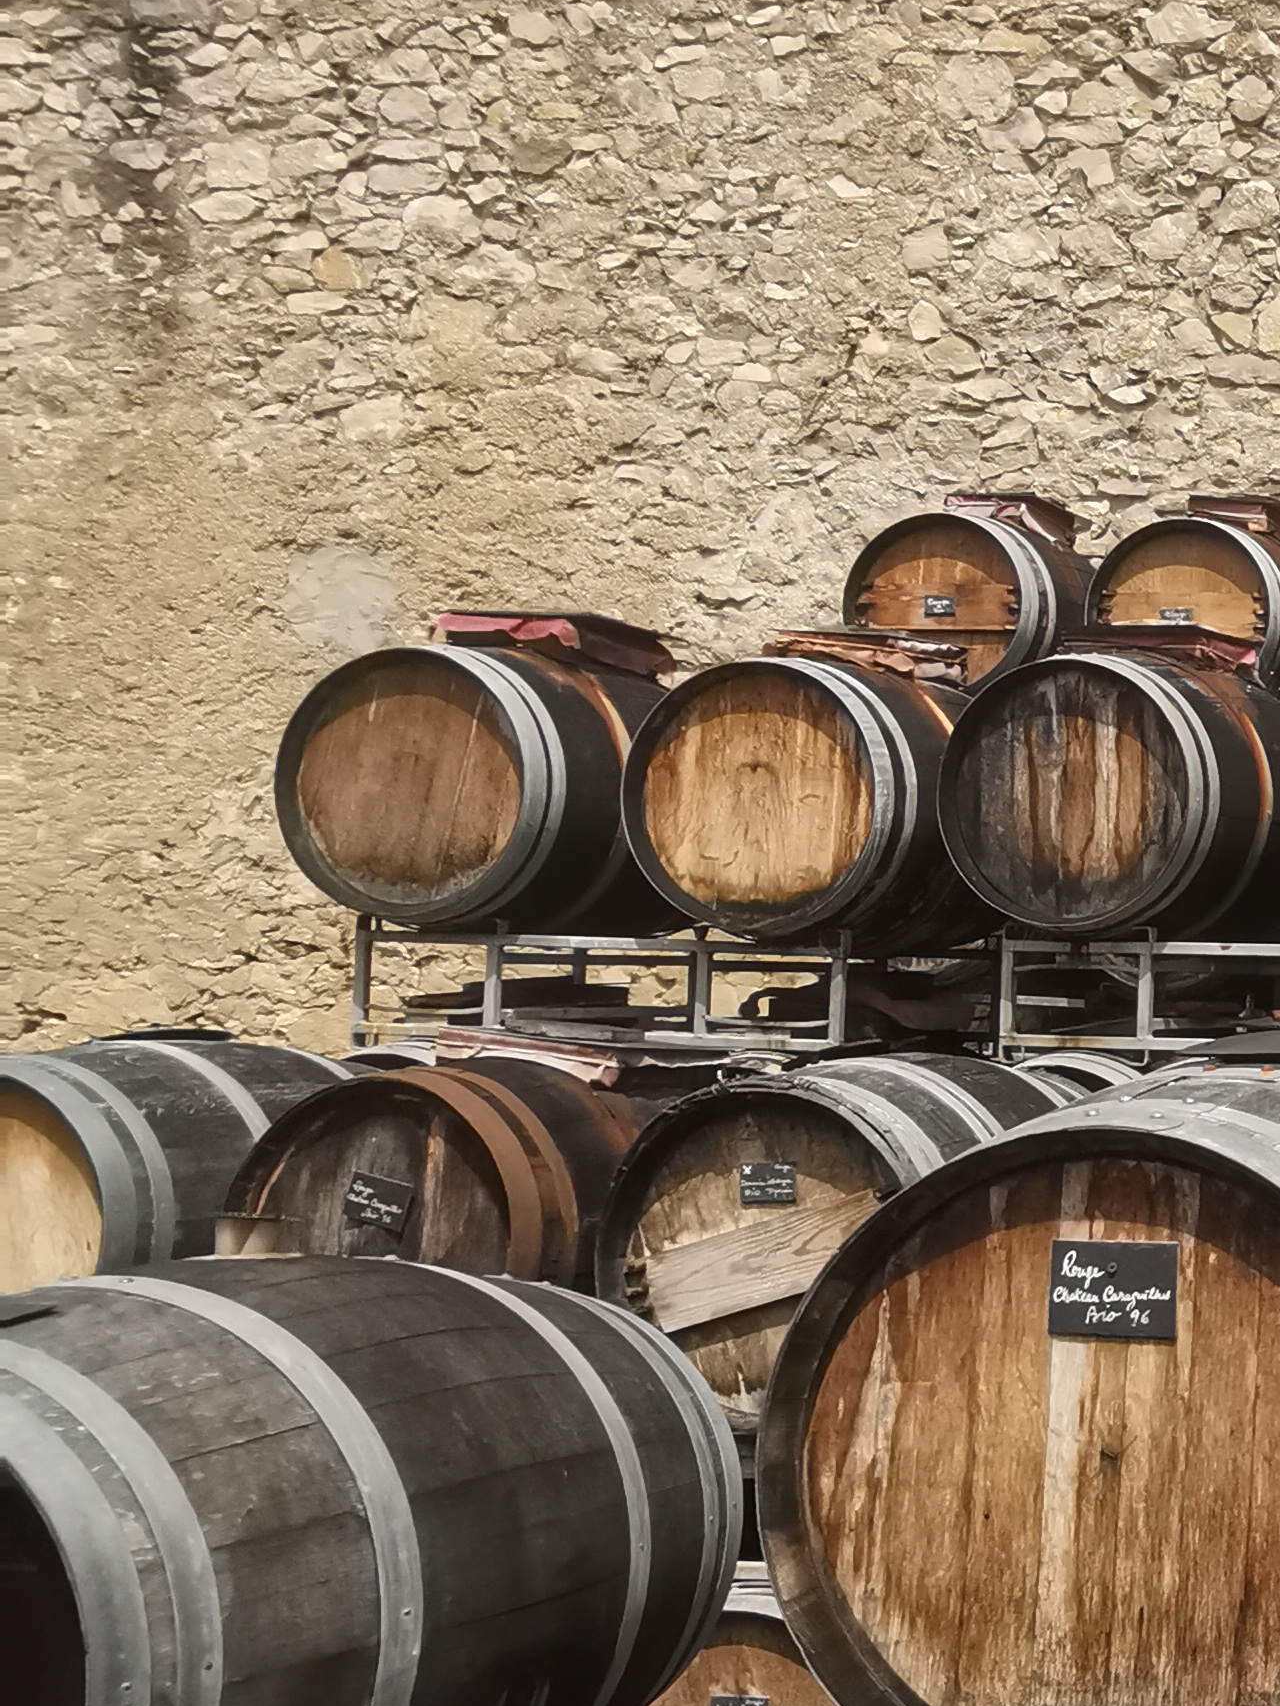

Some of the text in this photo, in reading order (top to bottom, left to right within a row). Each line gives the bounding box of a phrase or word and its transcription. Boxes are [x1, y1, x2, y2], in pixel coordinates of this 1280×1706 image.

[1061, 1250, 1105, 1290] Rouge
[1085, 1305, 1151, 1327] Bio 96
